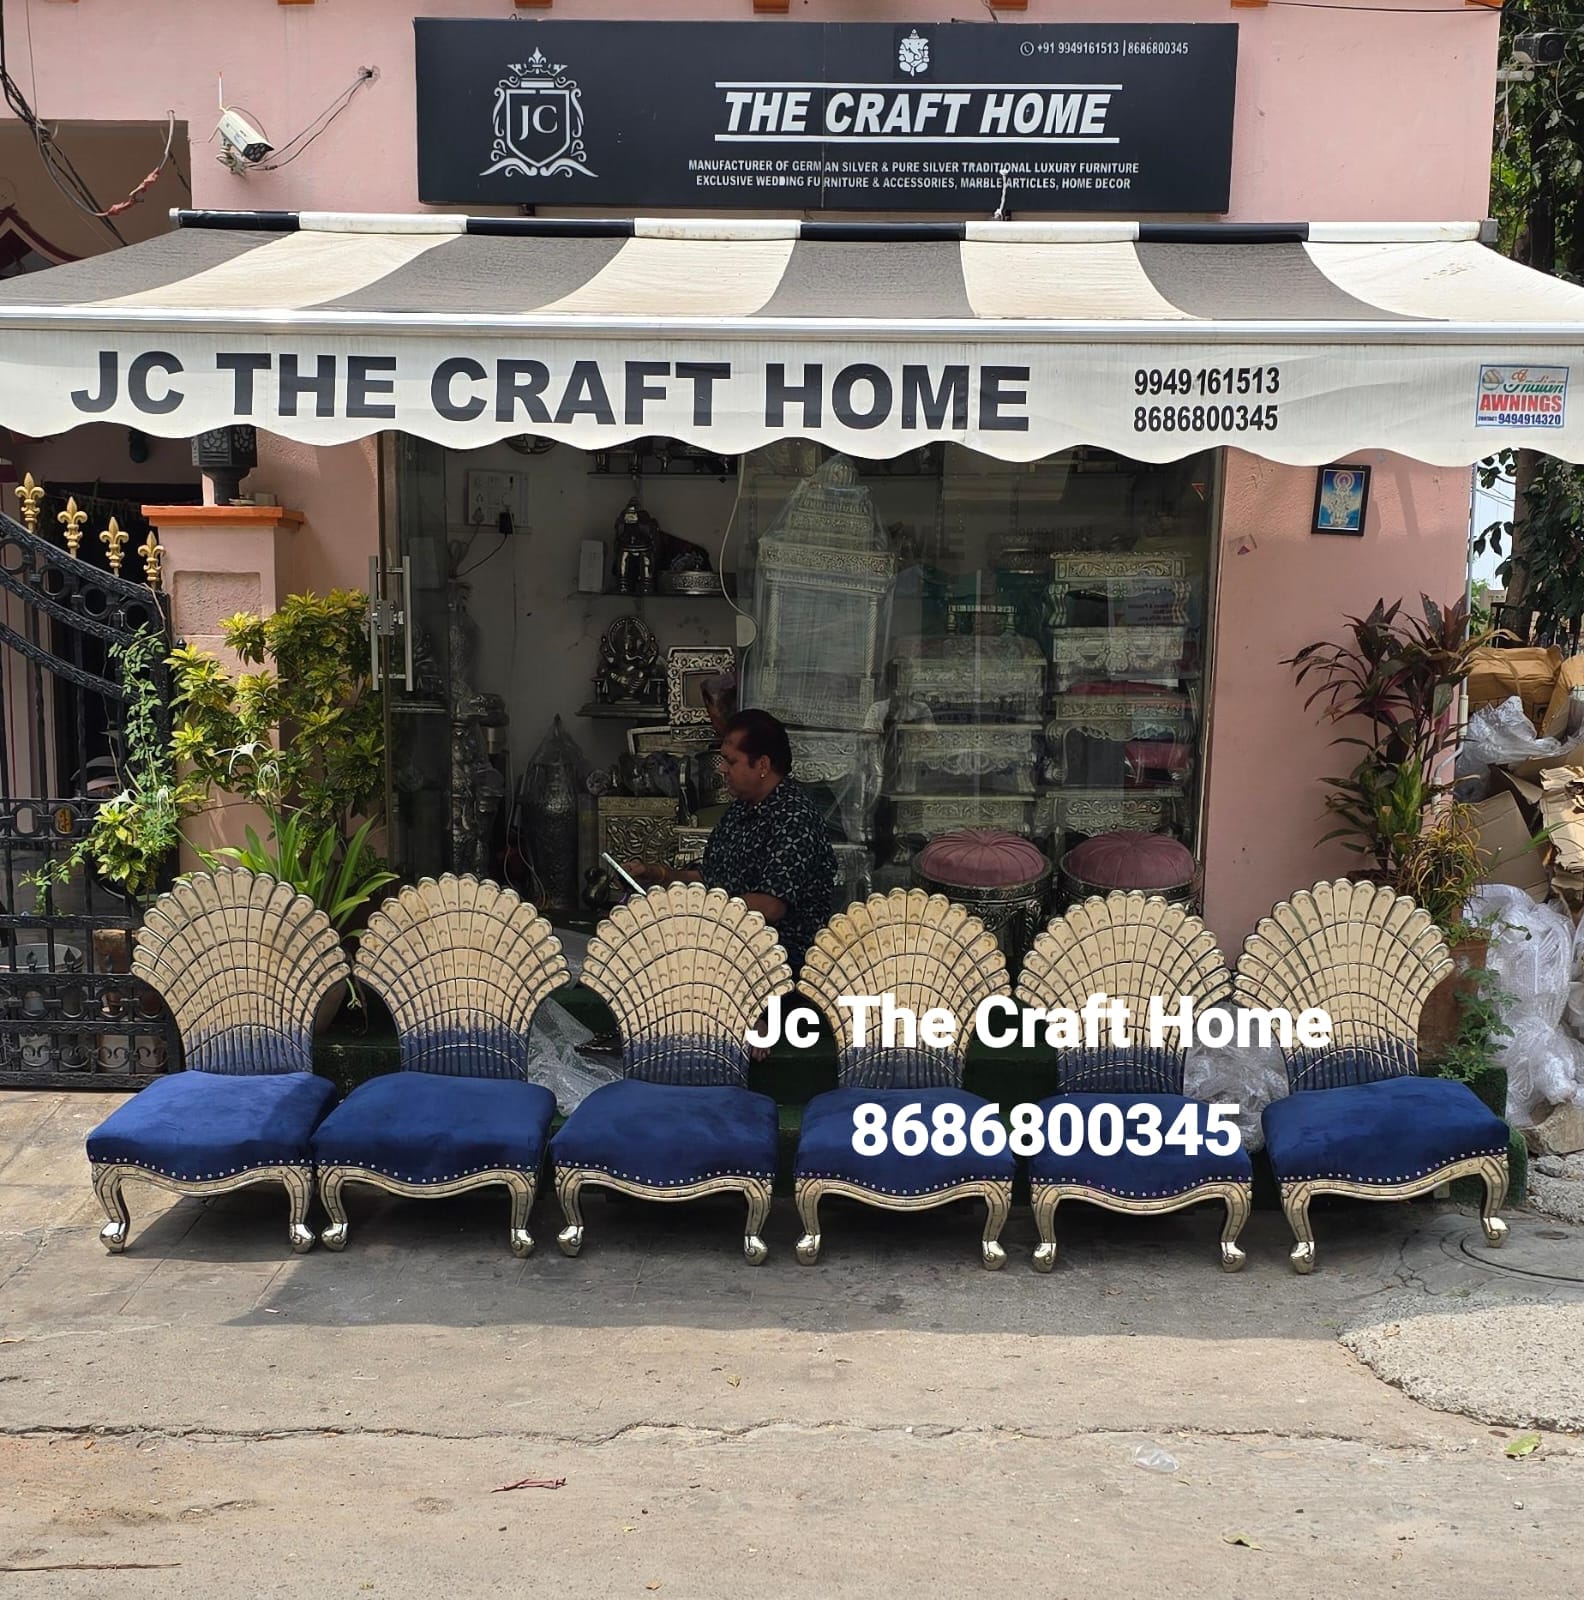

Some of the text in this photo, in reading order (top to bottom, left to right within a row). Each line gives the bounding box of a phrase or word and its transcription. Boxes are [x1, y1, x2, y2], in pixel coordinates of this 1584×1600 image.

[1037, 41, 1055, 54] +91
[1058, 41, 1119, 55] 9949161513
[519, 105, 558, 141] JC
[724, 91, 1112, 135] THE CRAFT HOME
[688, 159, 773, 172] MANUFACTURER
[775, 159, 789, 172] OF
[842, 161, 879, 173] SILVER
[881, 162, 889, 172] &
[892, 161, 920, 173] PURE
[922, 161, 959, 173] SILVER
[962, 162, 1032, 174] TRADITIONAL
[1034, 162, 1077, 174] LUXURY
[1079, 162, 1140, 174] FURNITURE
[696, 175, 754, 187] EXCLUSIVE
[756, 175, 805, 188] WEDDING
[807, 176, 869, 188] FURNITURE
[872, 177, 880, 188] &
[883, 177, 958, 190] ACCESSORIES,
[960, 177, 1002, 189] MARBLE
[1062, 177, 1093, 190] HOME
[1095, 178, 1131, 190] DECOR
[70, 350, 1031, 432] JC THE CRAFT HOME
[1134, 367, 1280, 396] 9949161513
[1479, 394, 1563, 412] AWNINGS
[1133, 405, 1278, 432] 8686800345
[1498, 413, 1562, 425] 9494914320
